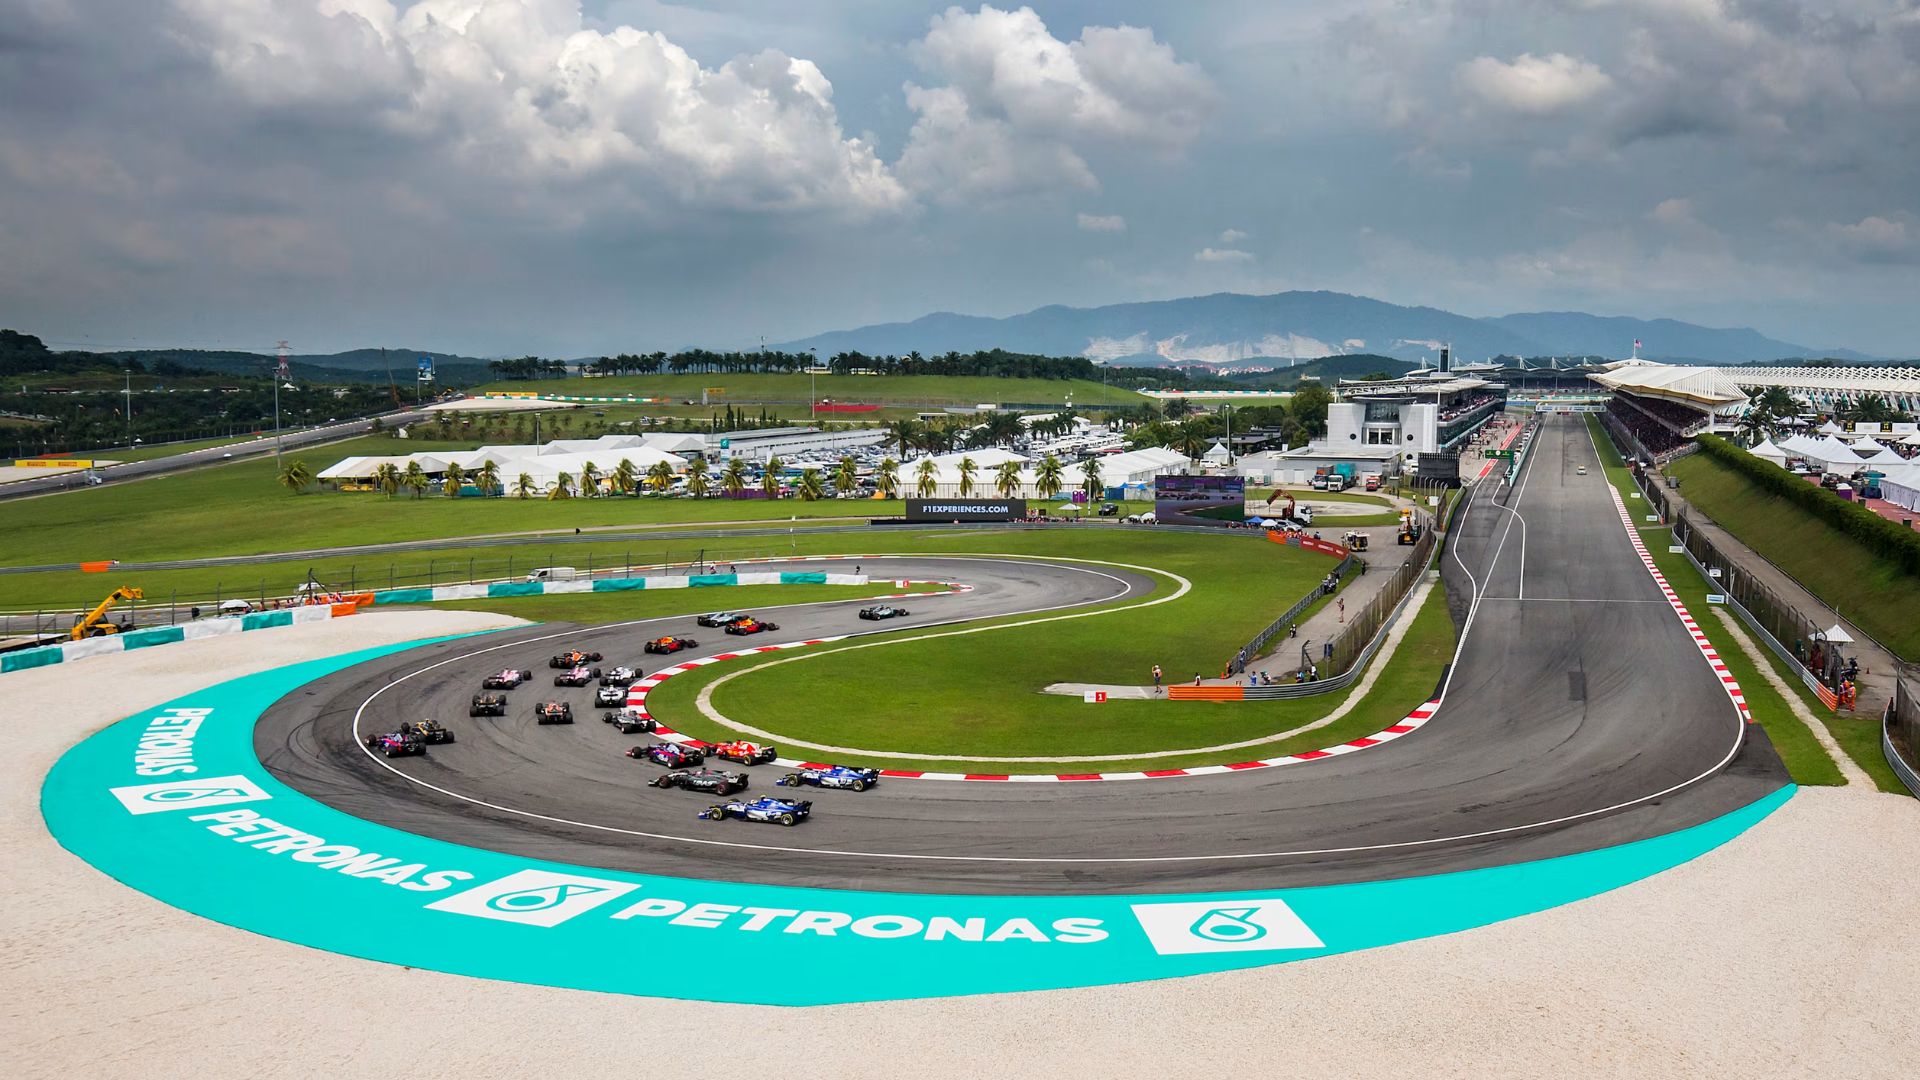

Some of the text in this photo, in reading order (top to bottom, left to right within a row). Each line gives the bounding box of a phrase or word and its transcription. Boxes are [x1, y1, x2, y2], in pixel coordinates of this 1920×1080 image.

[923, 505, 1009, 513] F1EXPERIENCES.COM
[135, 707, 214, 775] PETRONAS
[189, 808, 475, 892] PETRONAS
[611, 898, 1109, 943] PETRONAS
